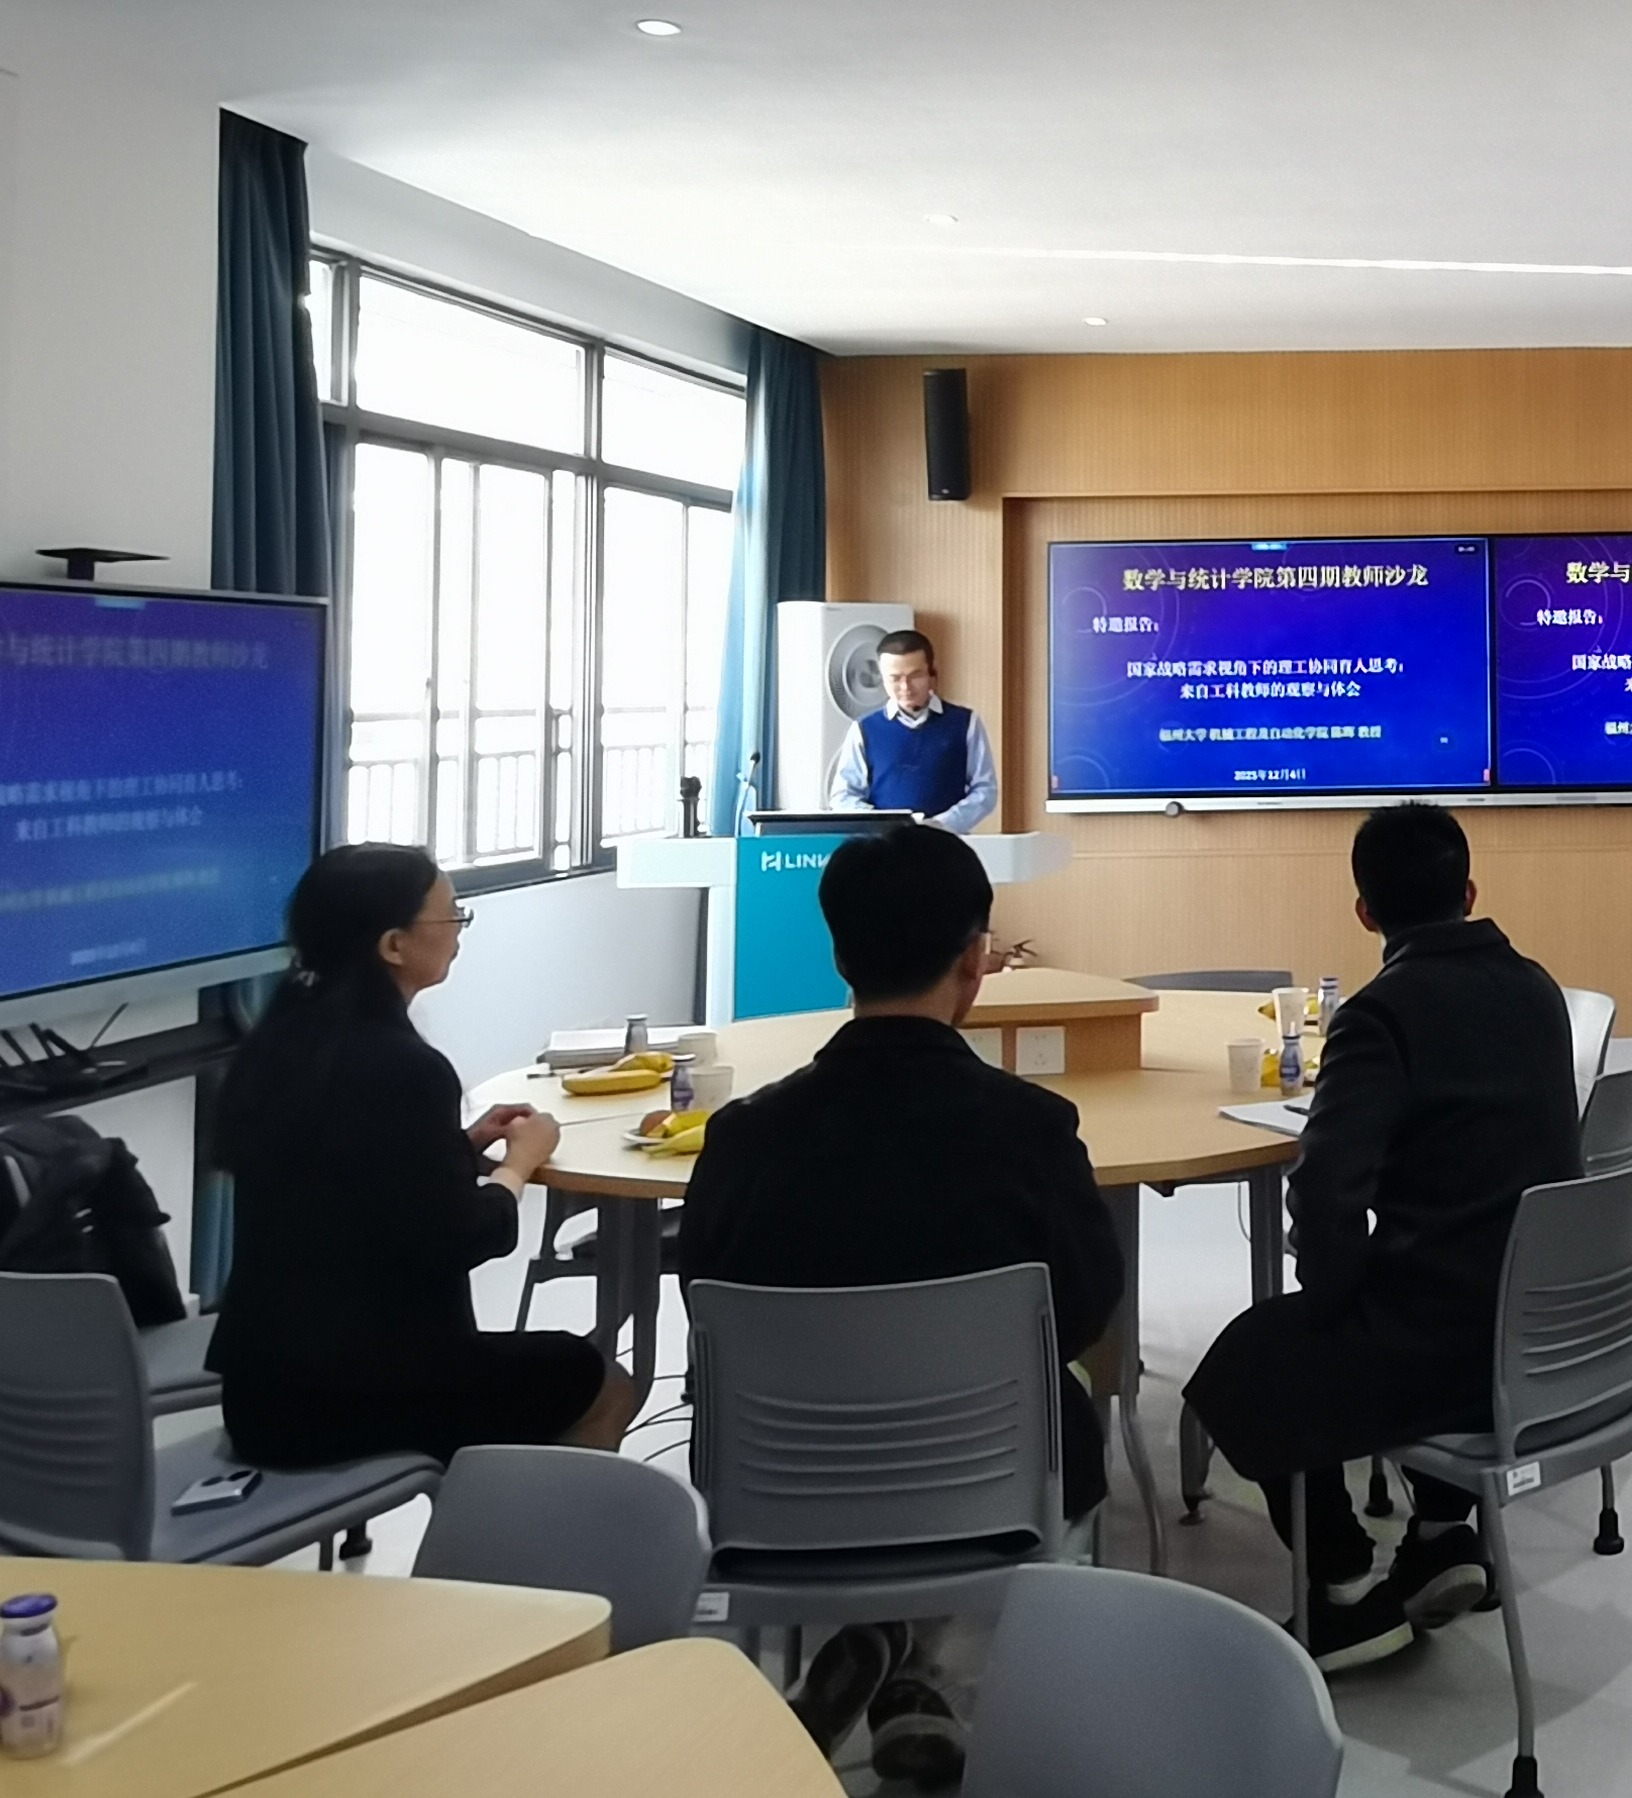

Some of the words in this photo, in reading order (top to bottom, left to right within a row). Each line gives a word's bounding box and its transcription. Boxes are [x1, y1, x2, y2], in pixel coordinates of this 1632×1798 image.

[1122, 564, 1429, 591] 数学与统计学院第四期教师沙龙
